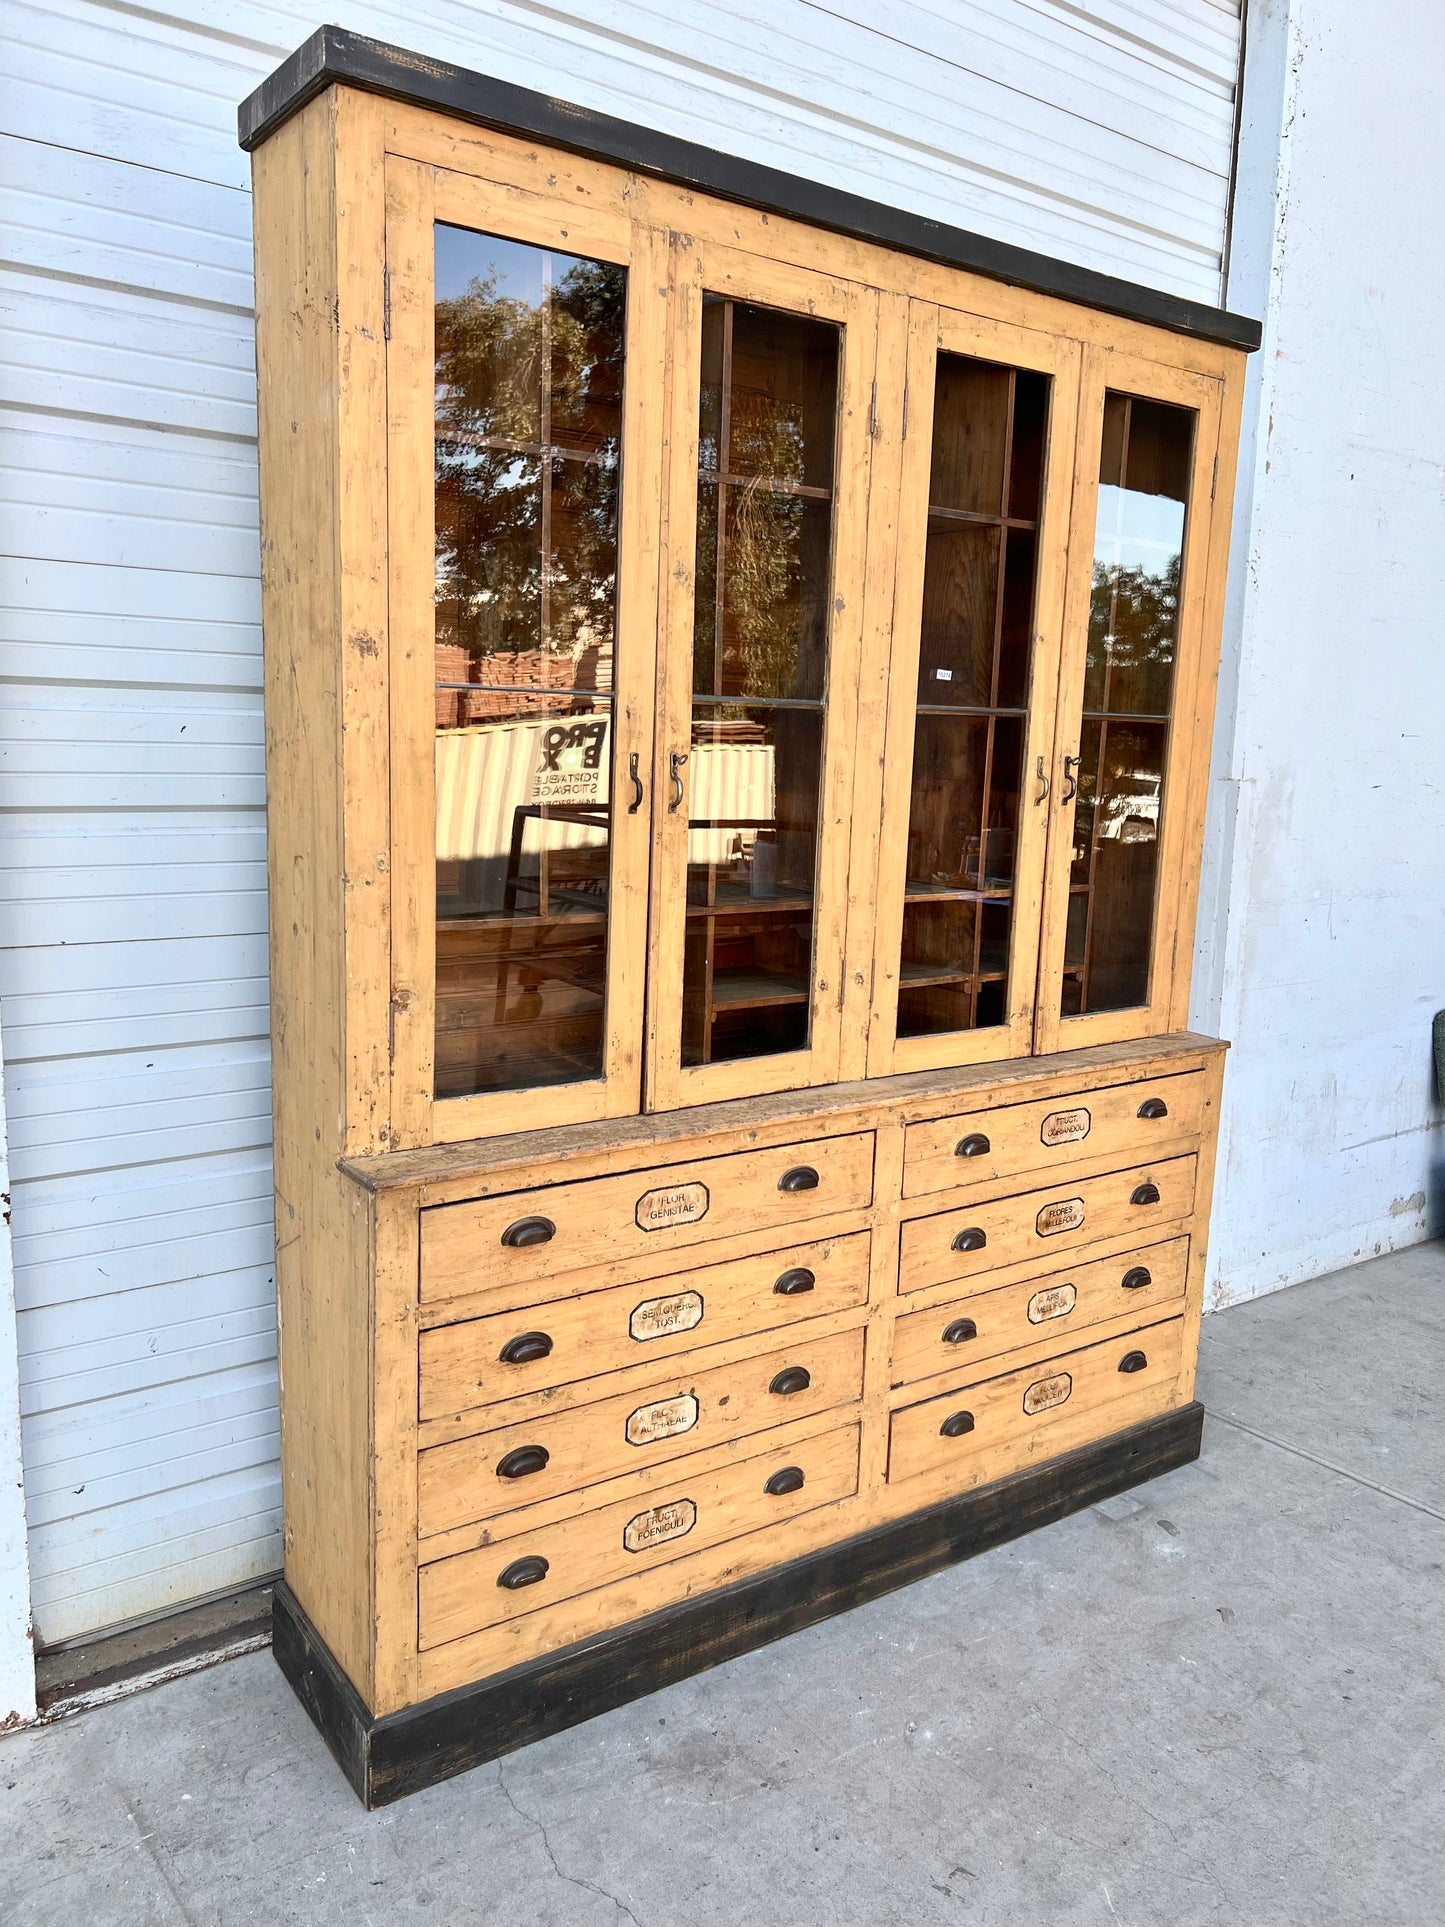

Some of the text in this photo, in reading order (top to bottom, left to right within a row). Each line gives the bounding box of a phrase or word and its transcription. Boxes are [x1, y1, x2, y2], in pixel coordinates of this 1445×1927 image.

[650, 1203, 695, 1220] GENISTAE
[1049, 1205, 1073, 1217] FLORES
[655, 1315, 681, 1329] TOST.
[637, 1517, 684, 1541] FOENICULI
